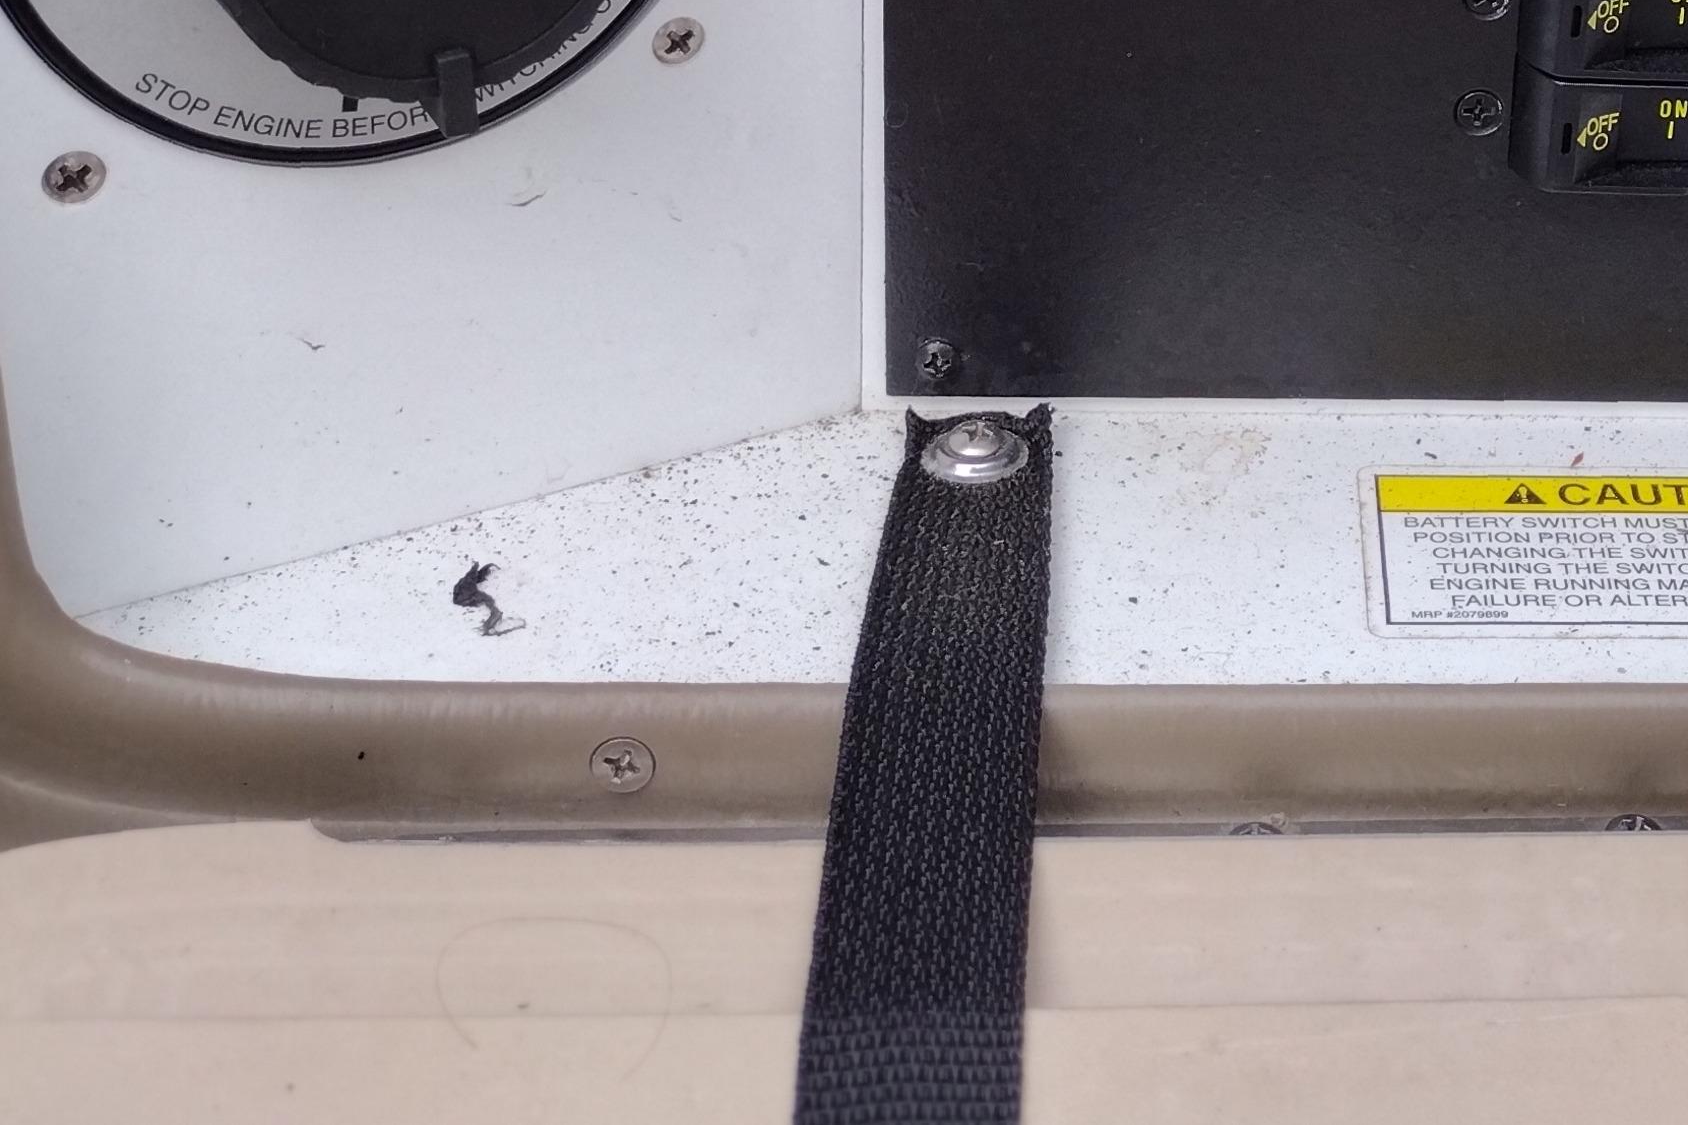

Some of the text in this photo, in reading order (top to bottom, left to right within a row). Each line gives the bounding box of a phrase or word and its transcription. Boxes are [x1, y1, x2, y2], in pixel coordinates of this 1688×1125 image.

[135, 72, 430, 140] STOP ENGINE BEFOR
[1586, 112, 1621, 137] OFF
[1403, 516, 1514, 529] BATTERY
[1521, 516, 1617, 529] SWITCH
[1413, 531, 1531, 544] POSITION
[1538, 531, 1618, 544] PRIOR
[1620, 532, 1656, 545] TO
[1432, 547, 1567, 559] CHANGING
[1571, 547, 1624, 559] THE
[1436, 562, 1552, 575] TURNING
[1558, 562, 1611, 575] THE
[1429, 578, 1526, 591] ENGINE
[1533, 578, 1651, 591] RUNNING
[1451, 594, 1556, 607] FAILURE
[1564, 594, 1603, 607] OR
[1411, 610, 1443, 619] MRP
